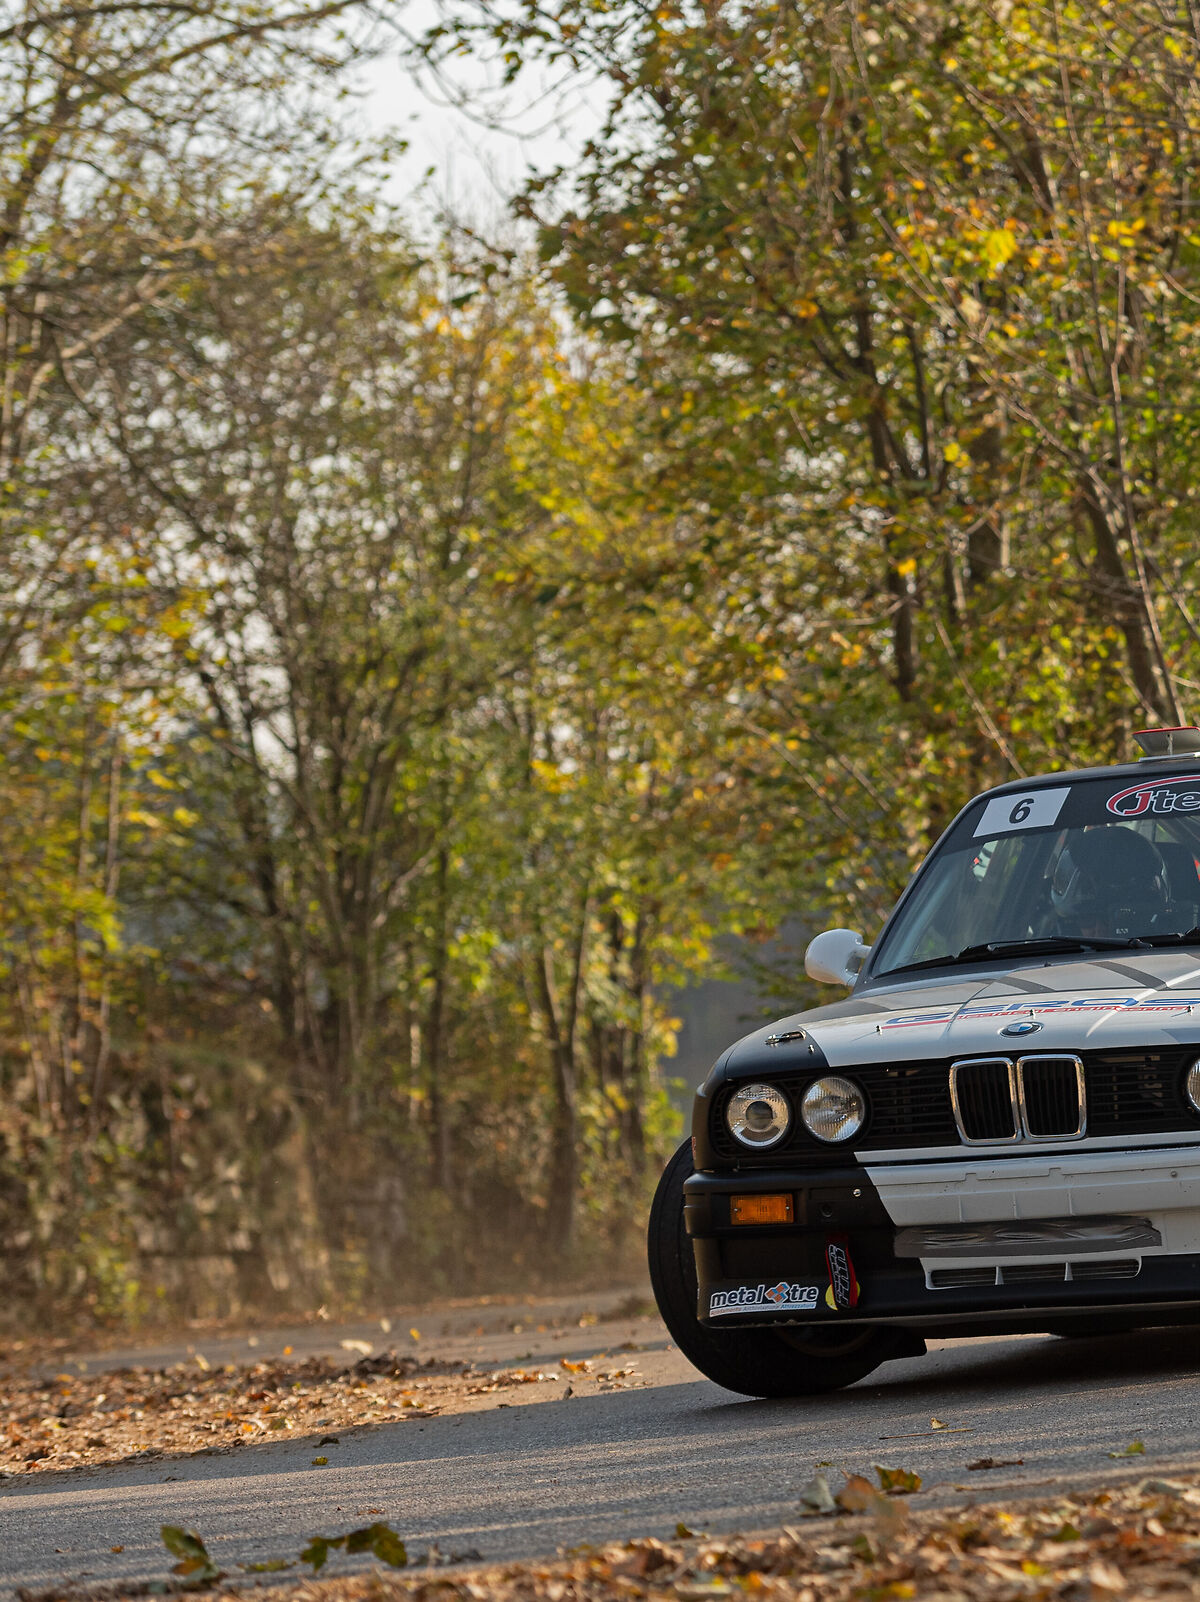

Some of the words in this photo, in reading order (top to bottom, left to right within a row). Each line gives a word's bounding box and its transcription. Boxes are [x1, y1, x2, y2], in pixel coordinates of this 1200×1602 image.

[1008, 798, 1035, 824] 6
[710, 1285, 765, 1309] metal
[789, 1284, 819, 1302] tre
